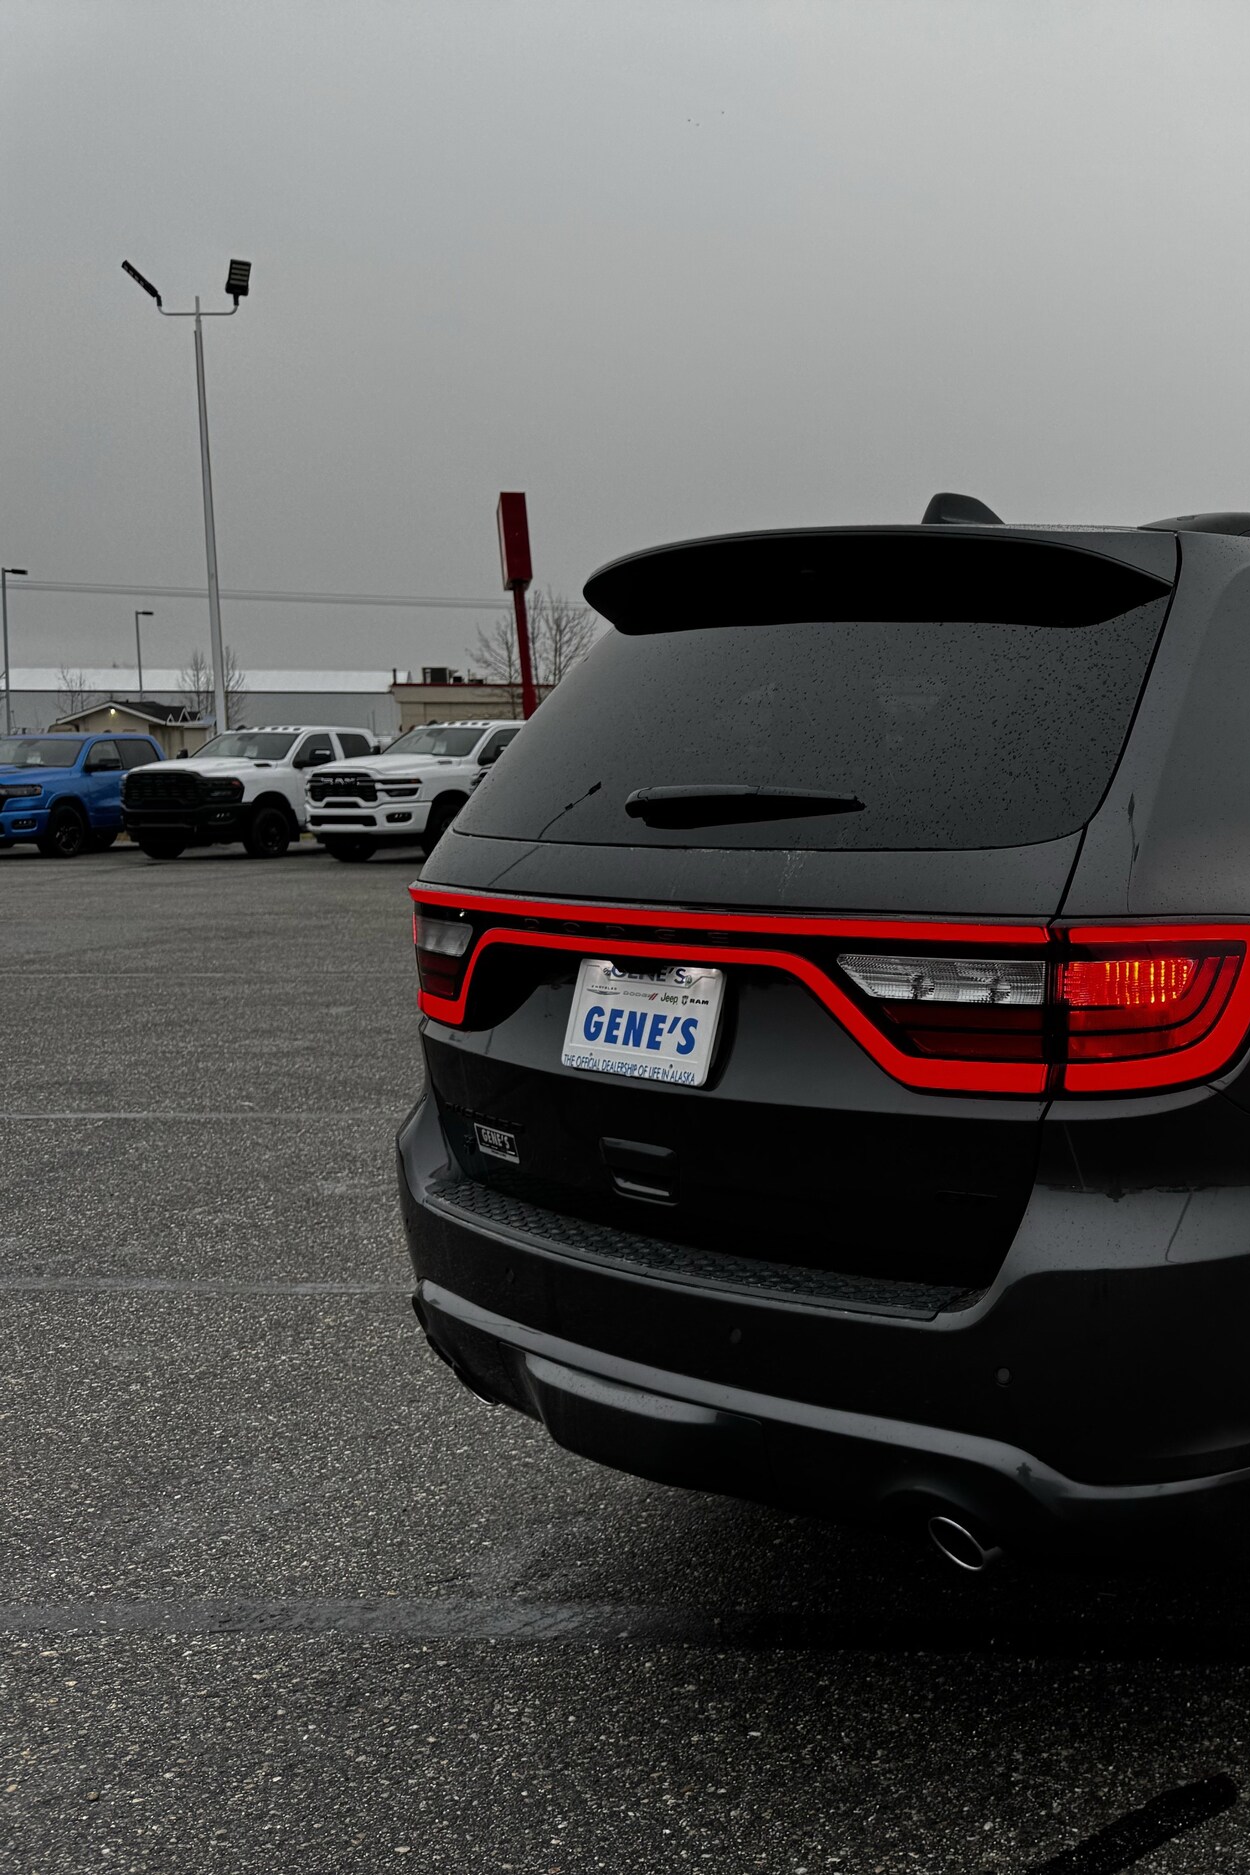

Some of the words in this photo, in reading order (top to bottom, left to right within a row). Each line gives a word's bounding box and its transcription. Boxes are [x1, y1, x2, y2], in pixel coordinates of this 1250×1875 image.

[524, 917, 729, 944] DODGE
[660, 992, 679, 1006] Jeep
[689, 998, 709, 1006] RAM
[583, 1005, 699, 1055] GENE'S
[564, 1053, 576, 1068] THE
[576, 1055, 600, 1071] OFFICIAL
[601, 1059, 638, 1076] DEALERSHIP
[638, 1064, 648, 1077] OF
[649, 1066, 661, 1079] LIFE
[661, 1068, 669, 1080] IN
[670, 1069, 695, 1085] ALASKA
[481, 1128, 510, 1149] GENE'S
